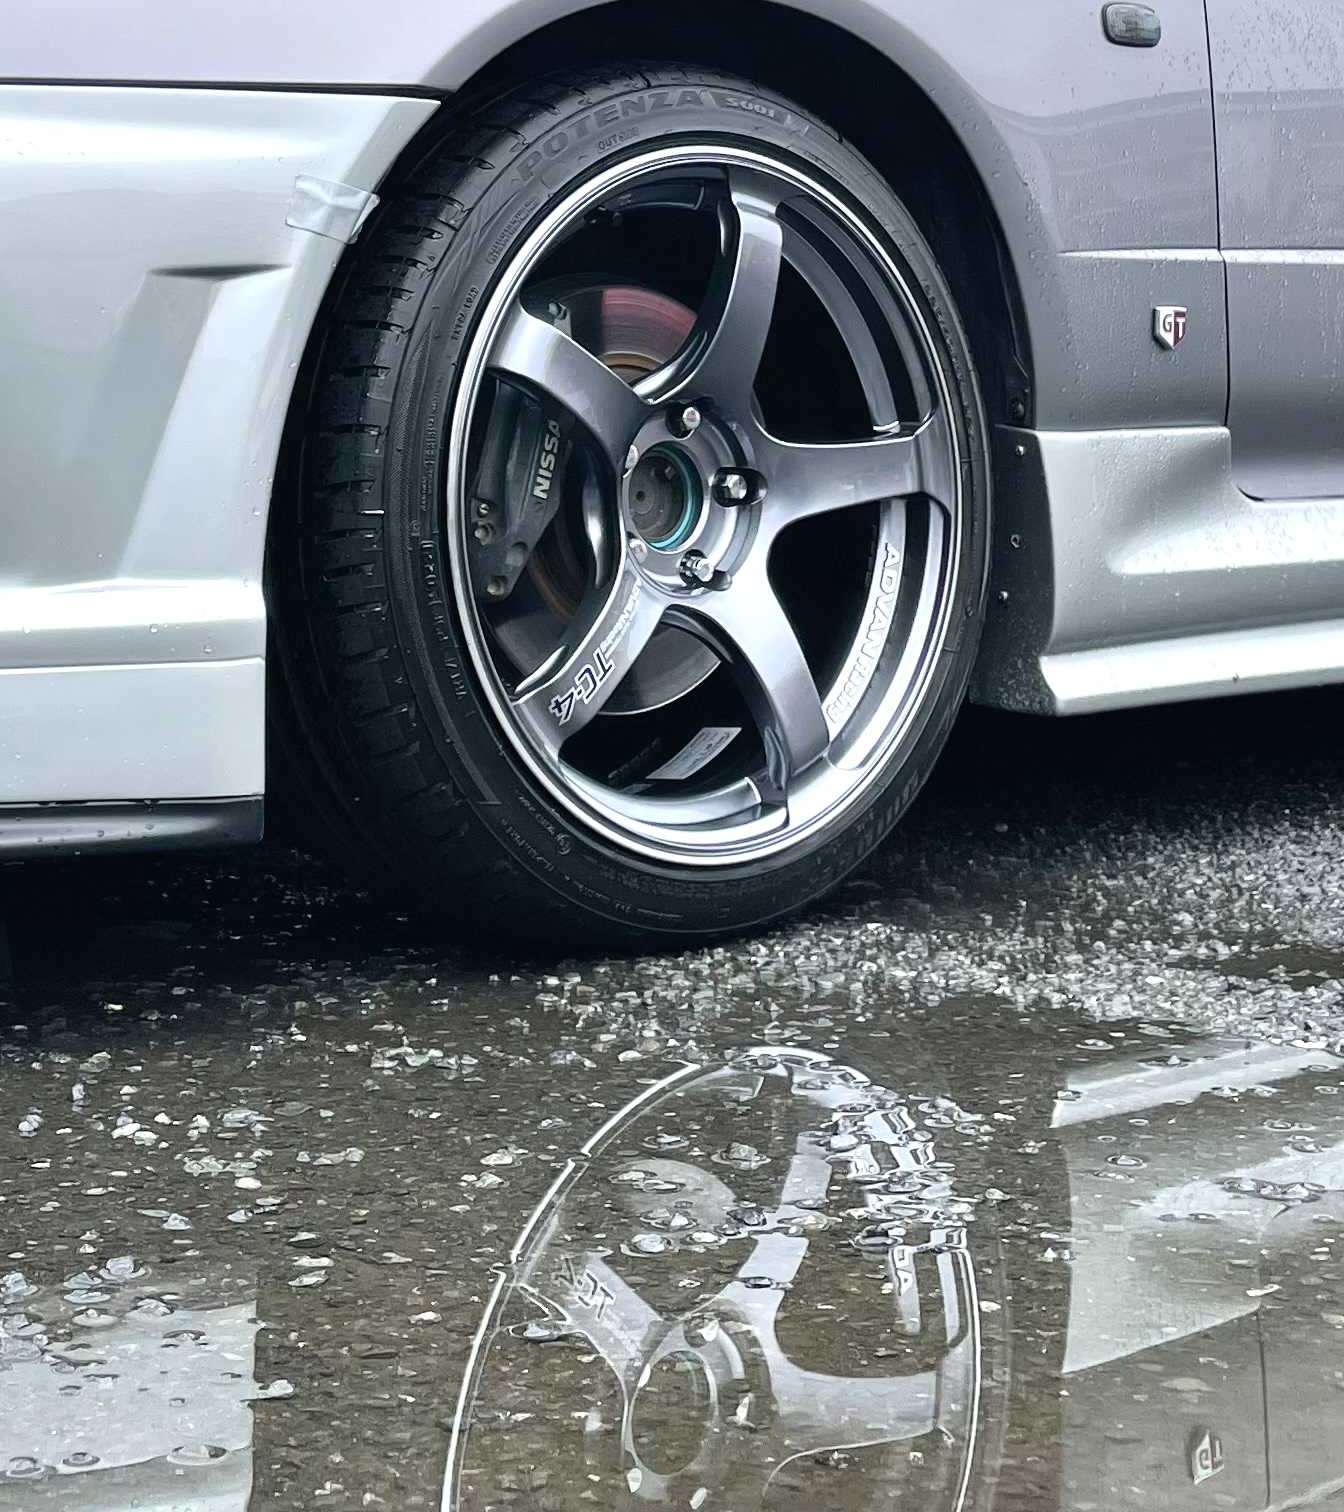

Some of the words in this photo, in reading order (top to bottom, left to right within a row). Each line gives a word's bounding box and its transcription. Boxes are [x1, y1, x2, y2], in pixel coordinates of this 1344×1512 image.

[511, 88, 706, 182] POTENZA
[1163, 313, 1186, 339] GT
[533, 419, 561, 500] NISSA
[548, 648, 617, 727] TC-4
